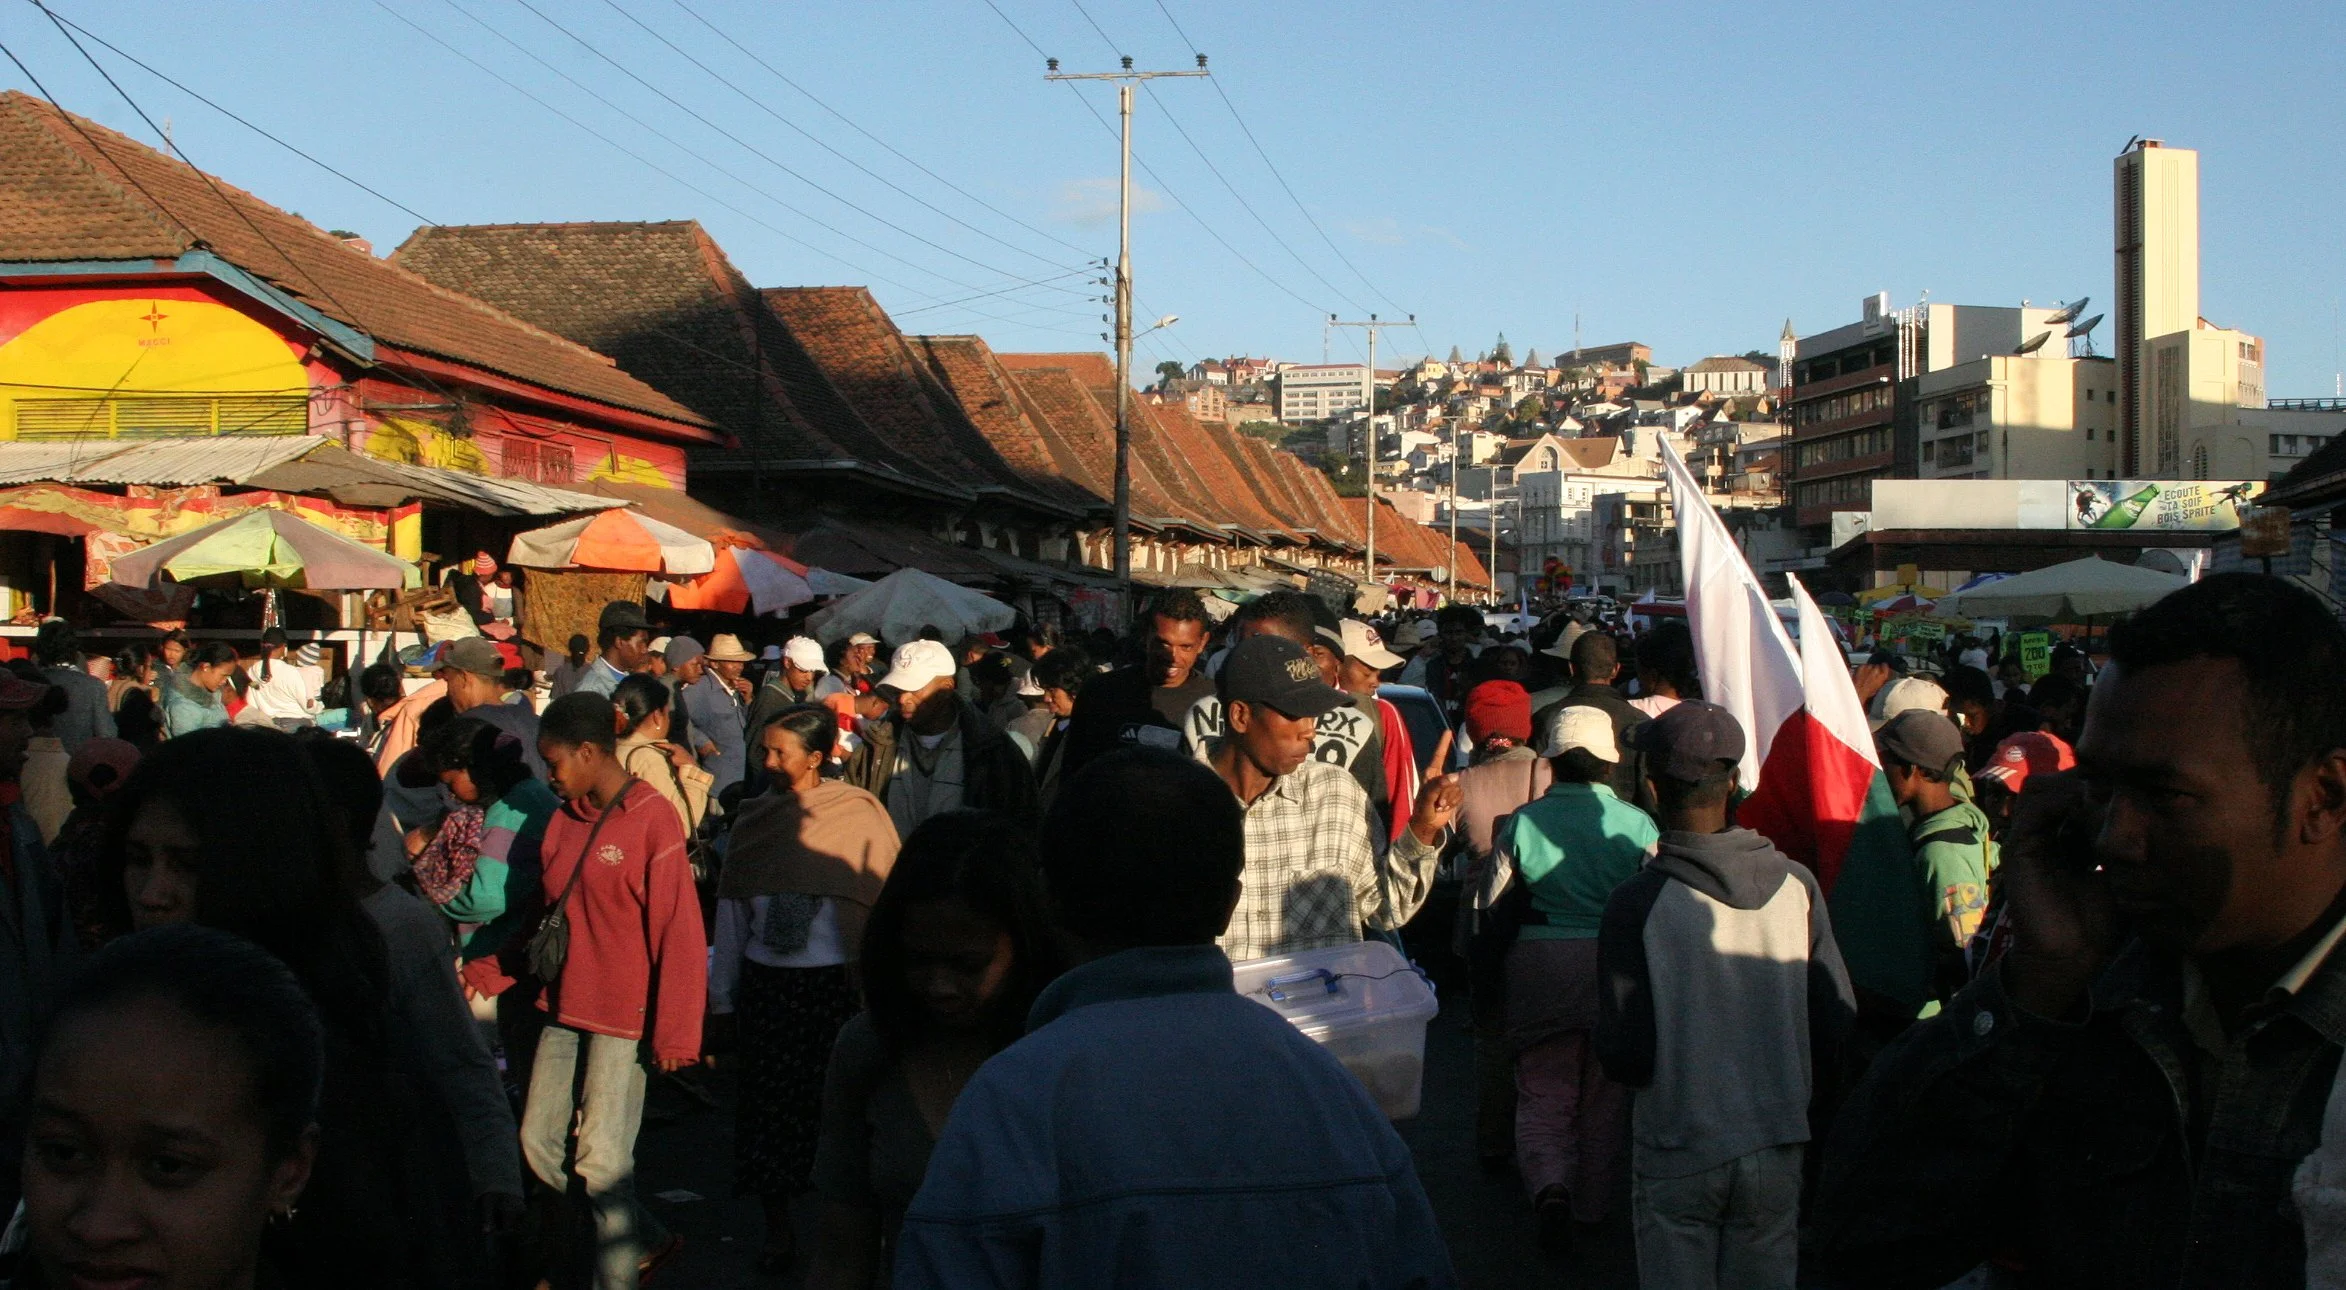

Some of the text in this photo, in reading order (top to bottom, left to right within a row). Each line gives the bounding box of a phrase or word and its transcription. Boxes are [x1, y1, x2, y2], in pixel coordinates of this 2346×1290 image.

[2164, 485, 2201, 501] ECOUTE
[2167, 496, 2203, 512] TA SOIF
[2157, 505, 2216, 525] BOIS SPRITE
